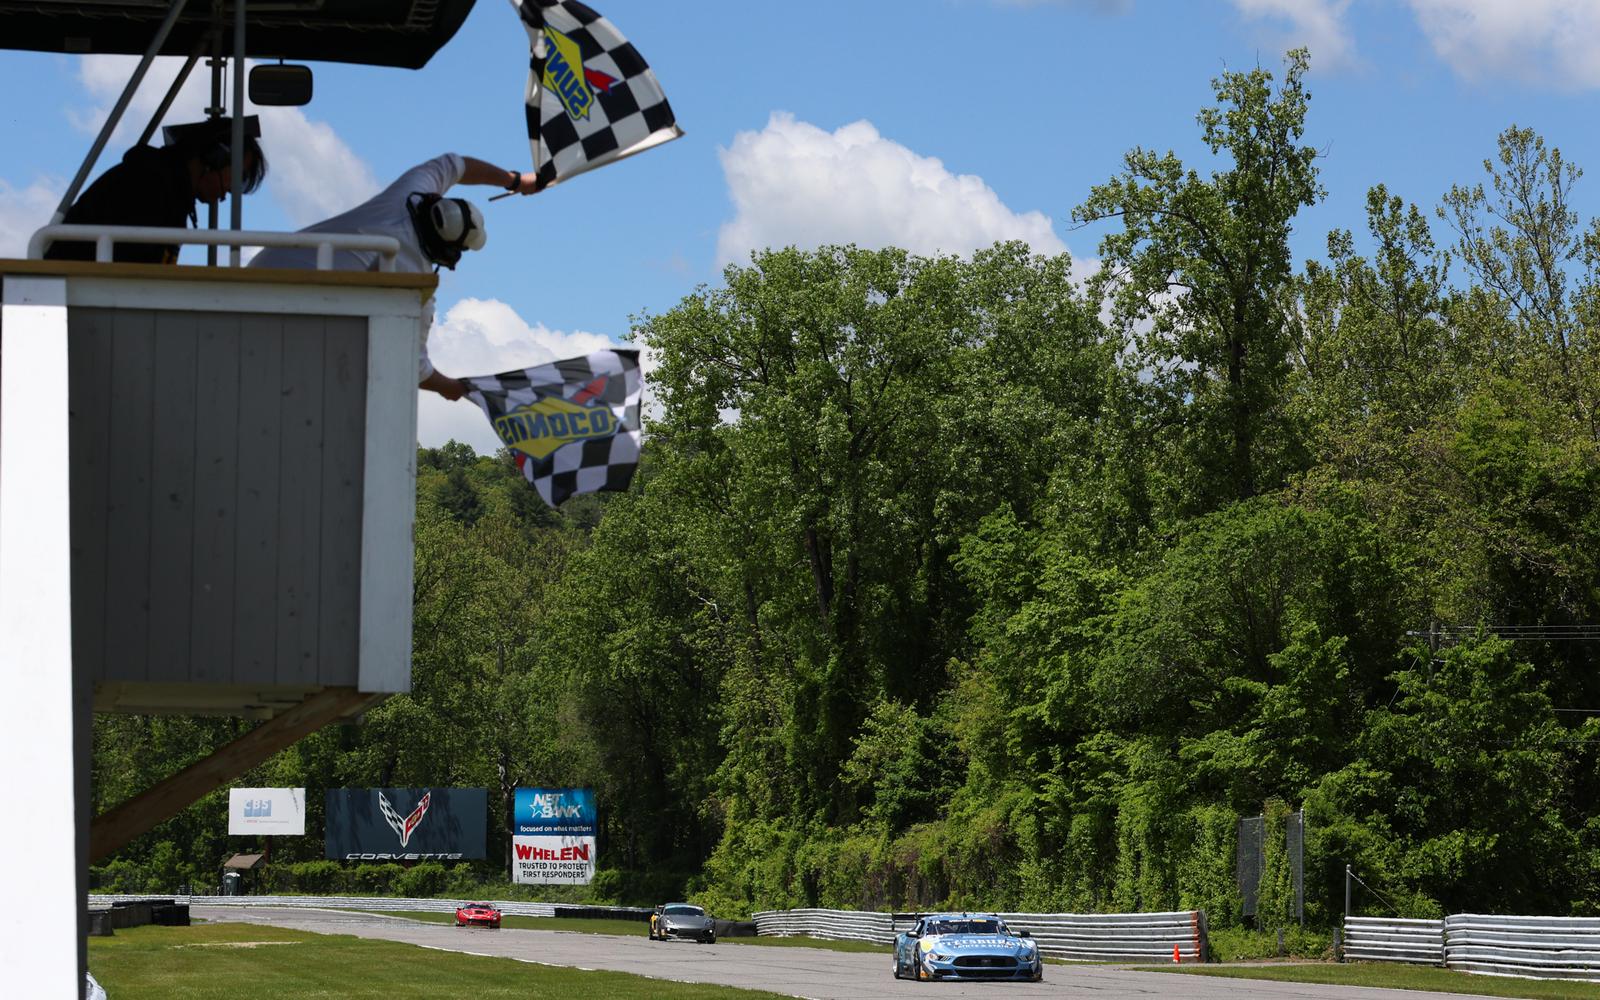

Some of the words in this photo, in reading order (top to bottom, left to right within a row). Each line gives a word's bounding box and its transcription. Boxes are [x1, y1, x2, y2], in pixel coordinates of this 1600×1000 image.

[244, 799, 270, 811] CBS
[540, 804, 582, 818] BANK
[515, 844, 589, 861] WHELEN
[519, 862, 548, 870] TRUSTED
[549, 862, 558, 870] TO
[559, 862, 588, 870] PROTECT
